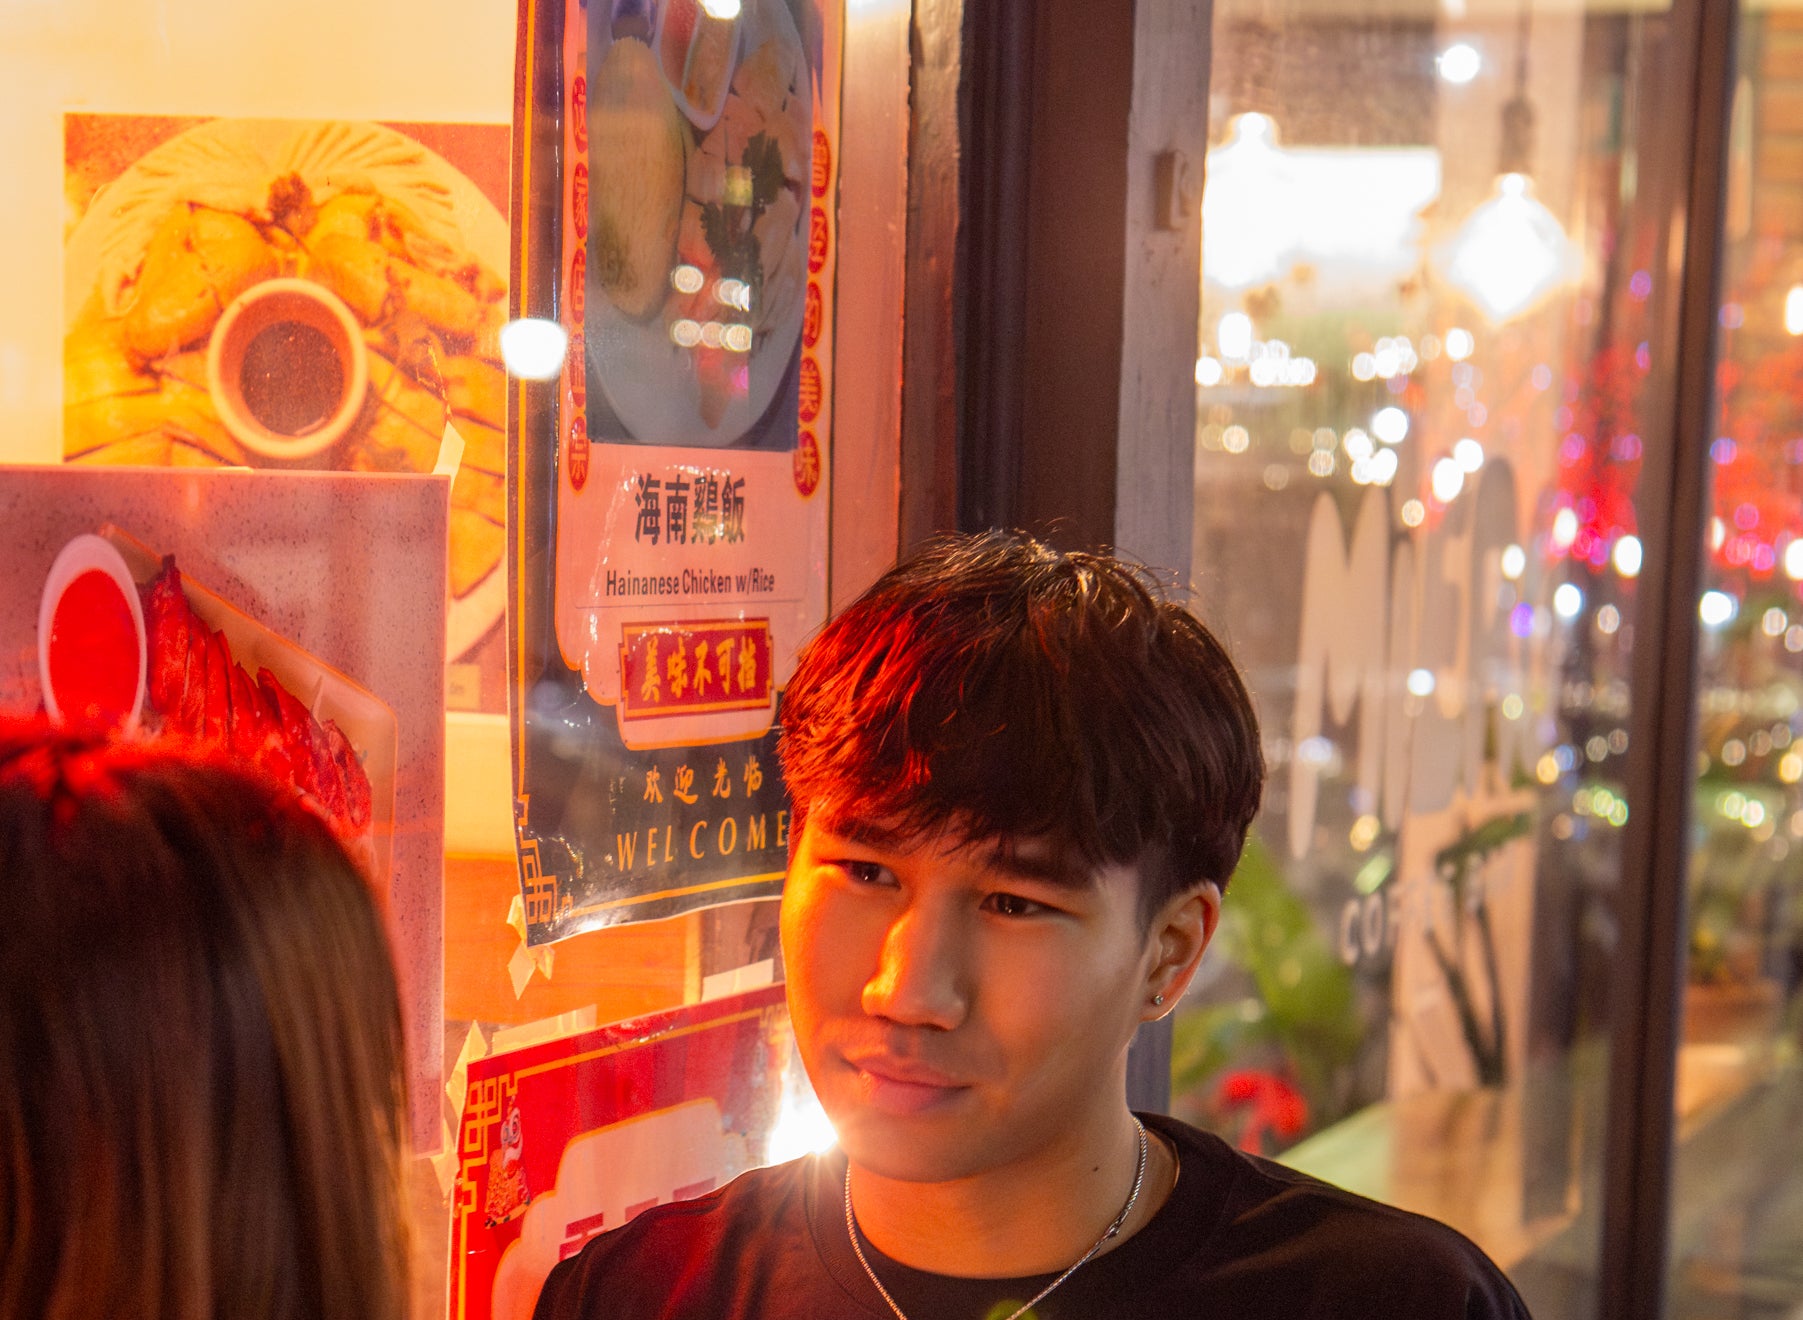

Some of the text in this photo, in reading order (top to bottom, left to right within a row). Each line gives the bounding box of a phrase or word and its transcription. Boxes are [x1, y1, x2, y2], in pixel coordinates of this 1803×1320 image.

[606, 567, 775, 596] Hainanese Chicken w/Rice
[643, 756, 763, 805] 欢迎光临
[616, 810, 788, 872] WELCOME
